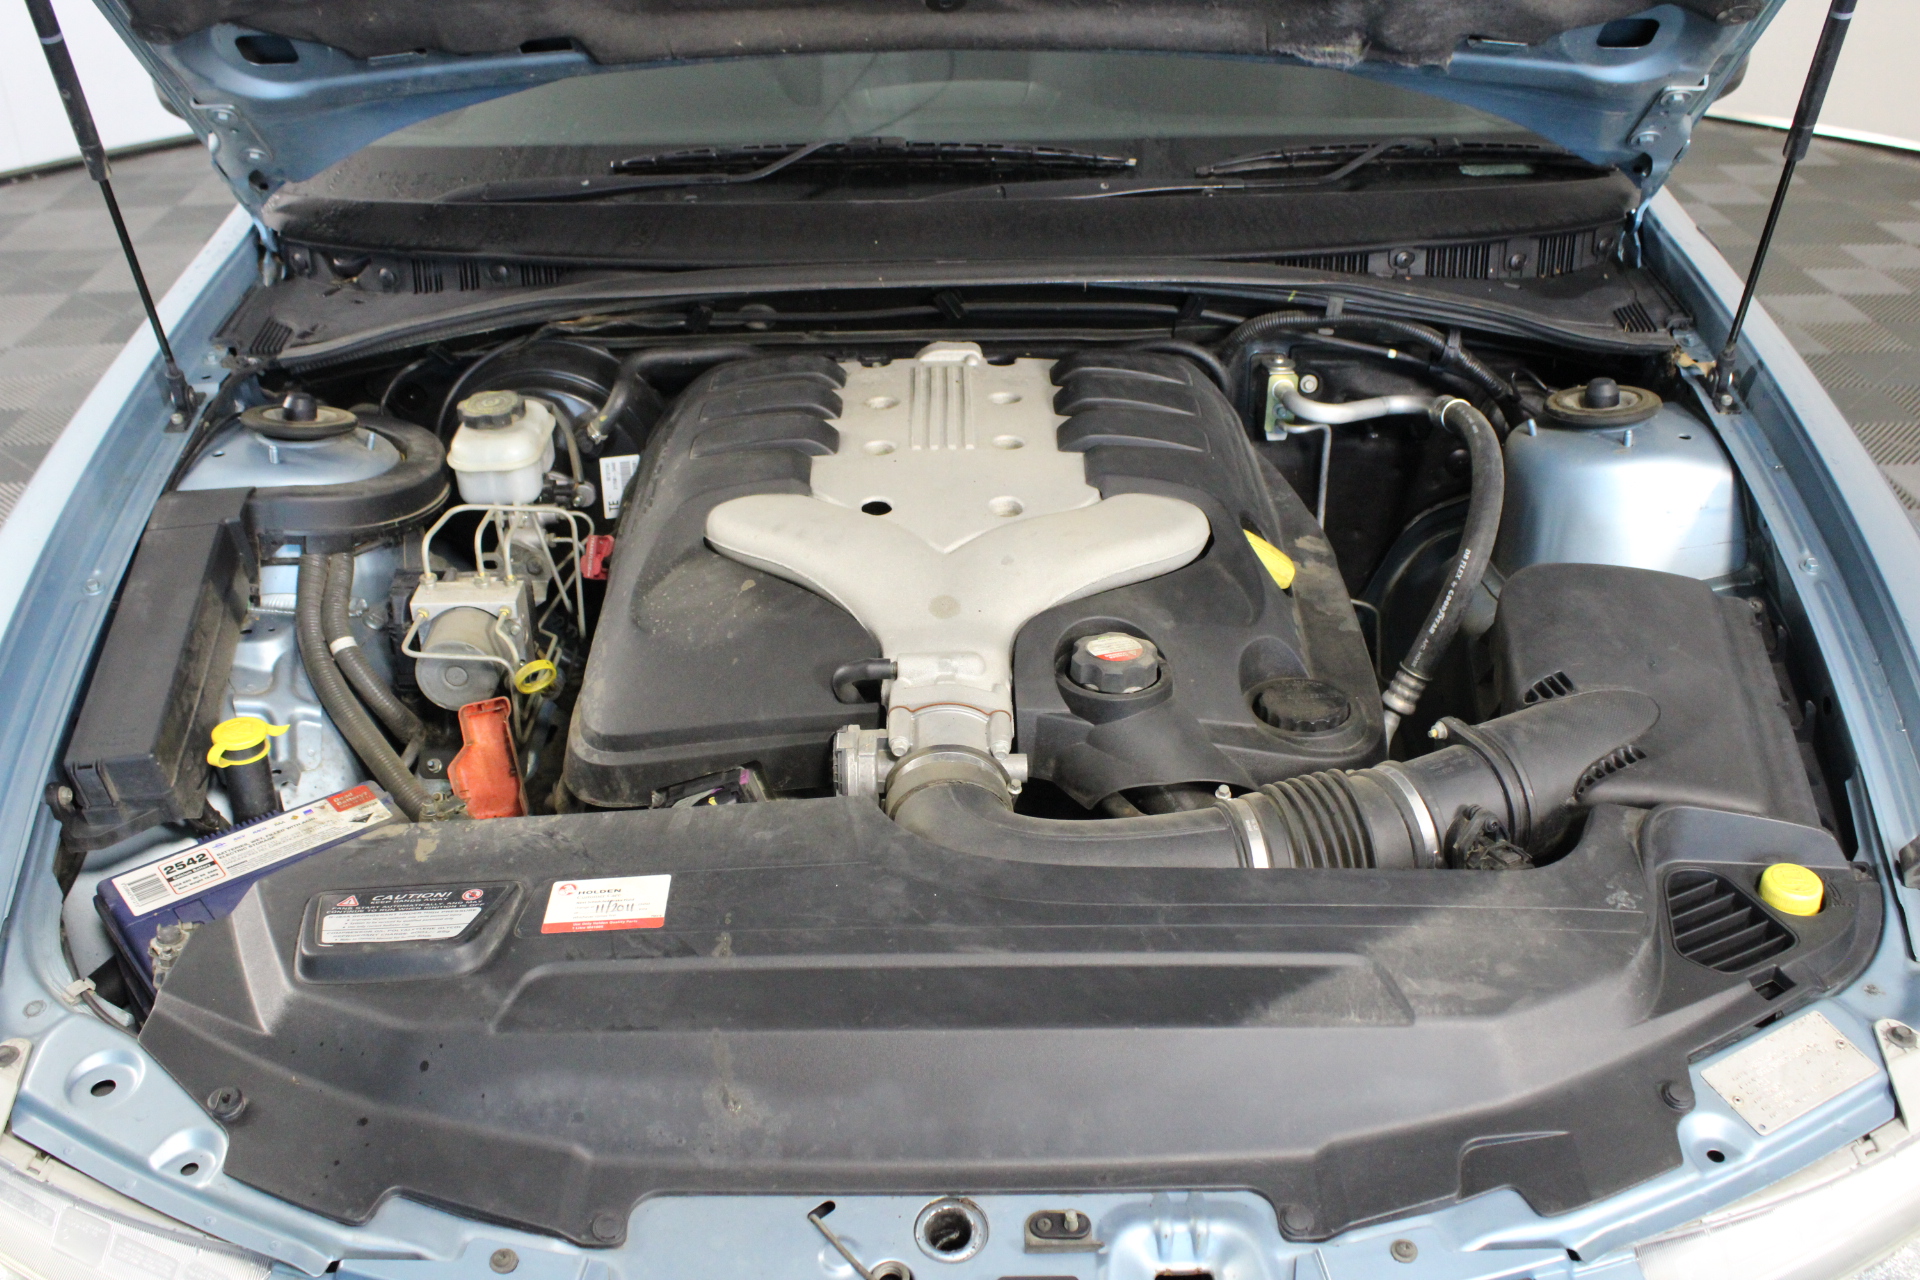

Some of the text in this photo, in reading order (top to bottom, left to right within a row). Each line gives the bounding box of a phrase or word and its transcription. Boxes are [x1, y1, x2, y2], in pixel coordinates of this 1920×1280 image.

[1455, 560, 1467, 580] FLEX
[164, 853, 209, 875] 2542
[373, 892, 451, 902] CAUTION!
